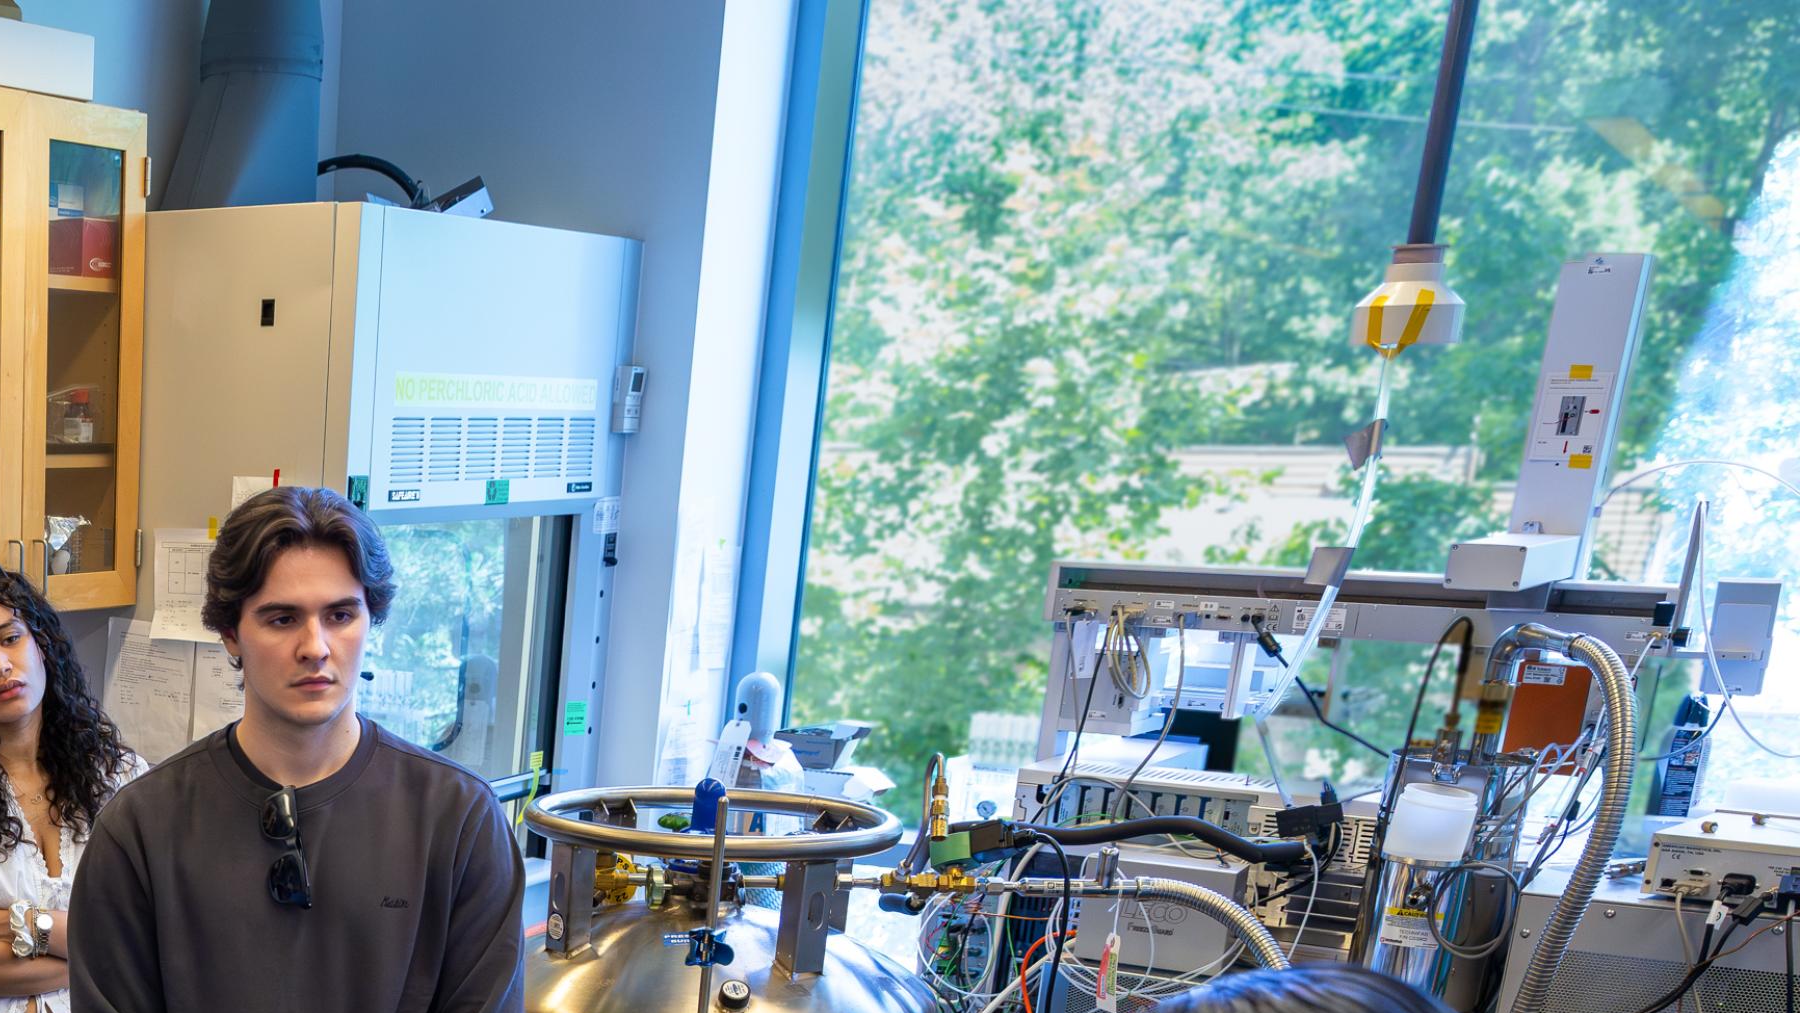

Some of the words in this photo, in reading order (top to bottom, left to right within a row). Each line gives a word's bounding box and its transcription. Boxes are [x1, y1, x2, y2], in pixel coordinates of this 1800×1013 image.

[395, 376, 415, 400] NO
[419, 377, 504, 402] PERCHLORIC
[509, 383, 537, 403] ACID
[541, 383, 596, 404] ALLOWED
